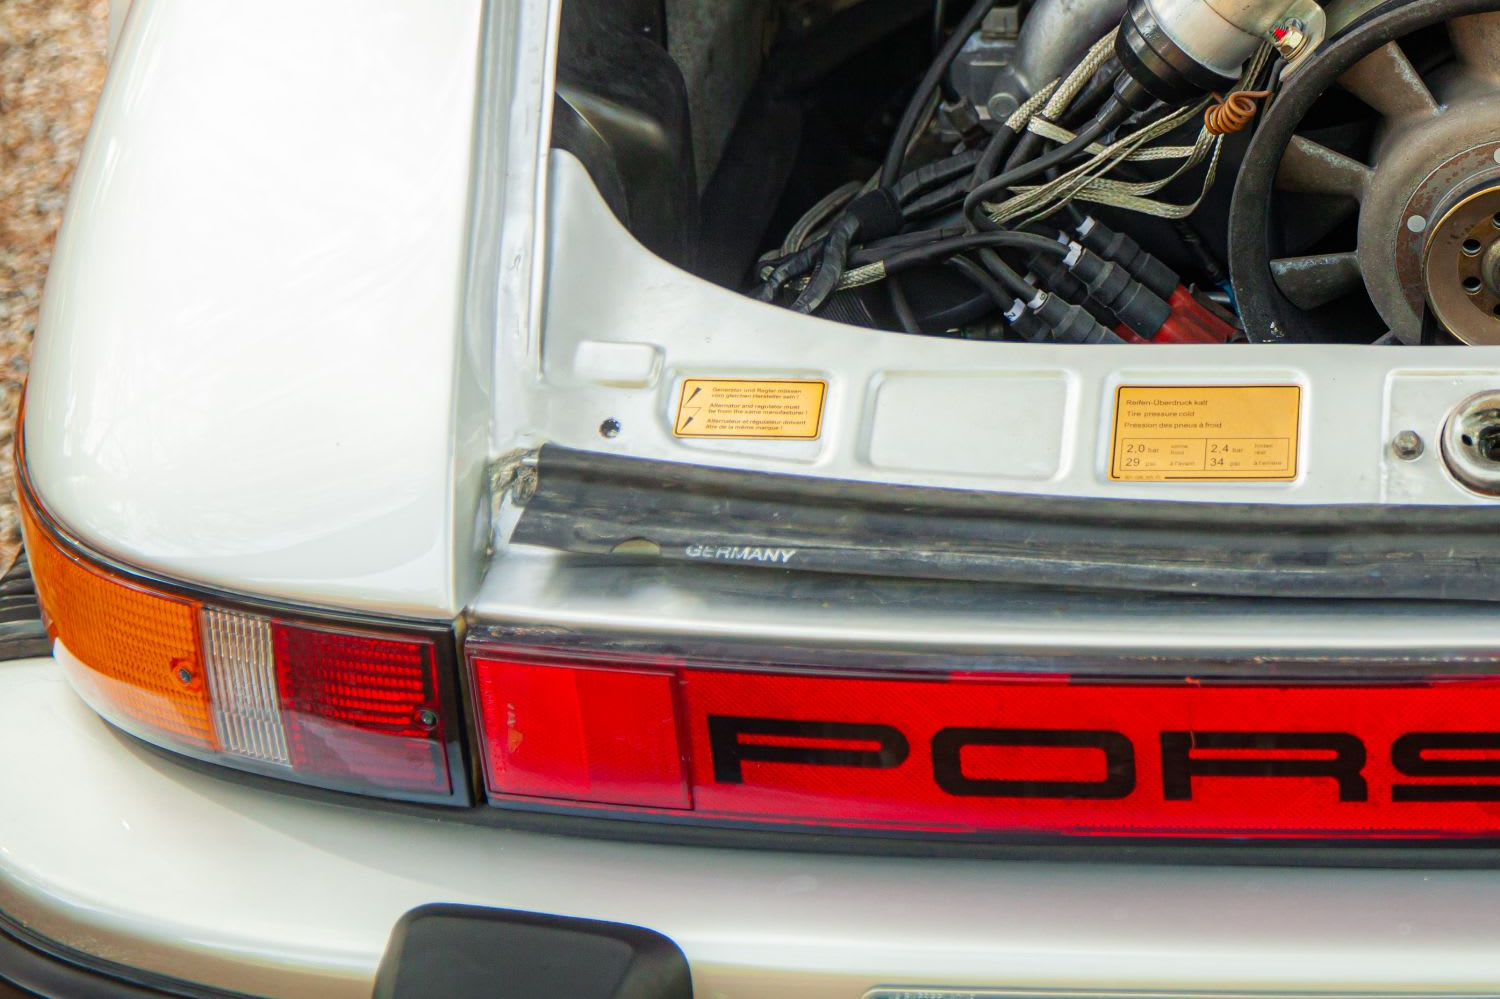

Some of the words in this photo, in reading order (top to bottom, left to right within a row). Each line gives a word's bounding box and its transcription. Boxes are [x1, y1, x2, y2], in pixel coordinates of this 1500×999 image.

[1125, 457, 1140, 467] 29
[1209, 457, 1224, 467] 34
[685, 544, 797, 563] GERMANY
